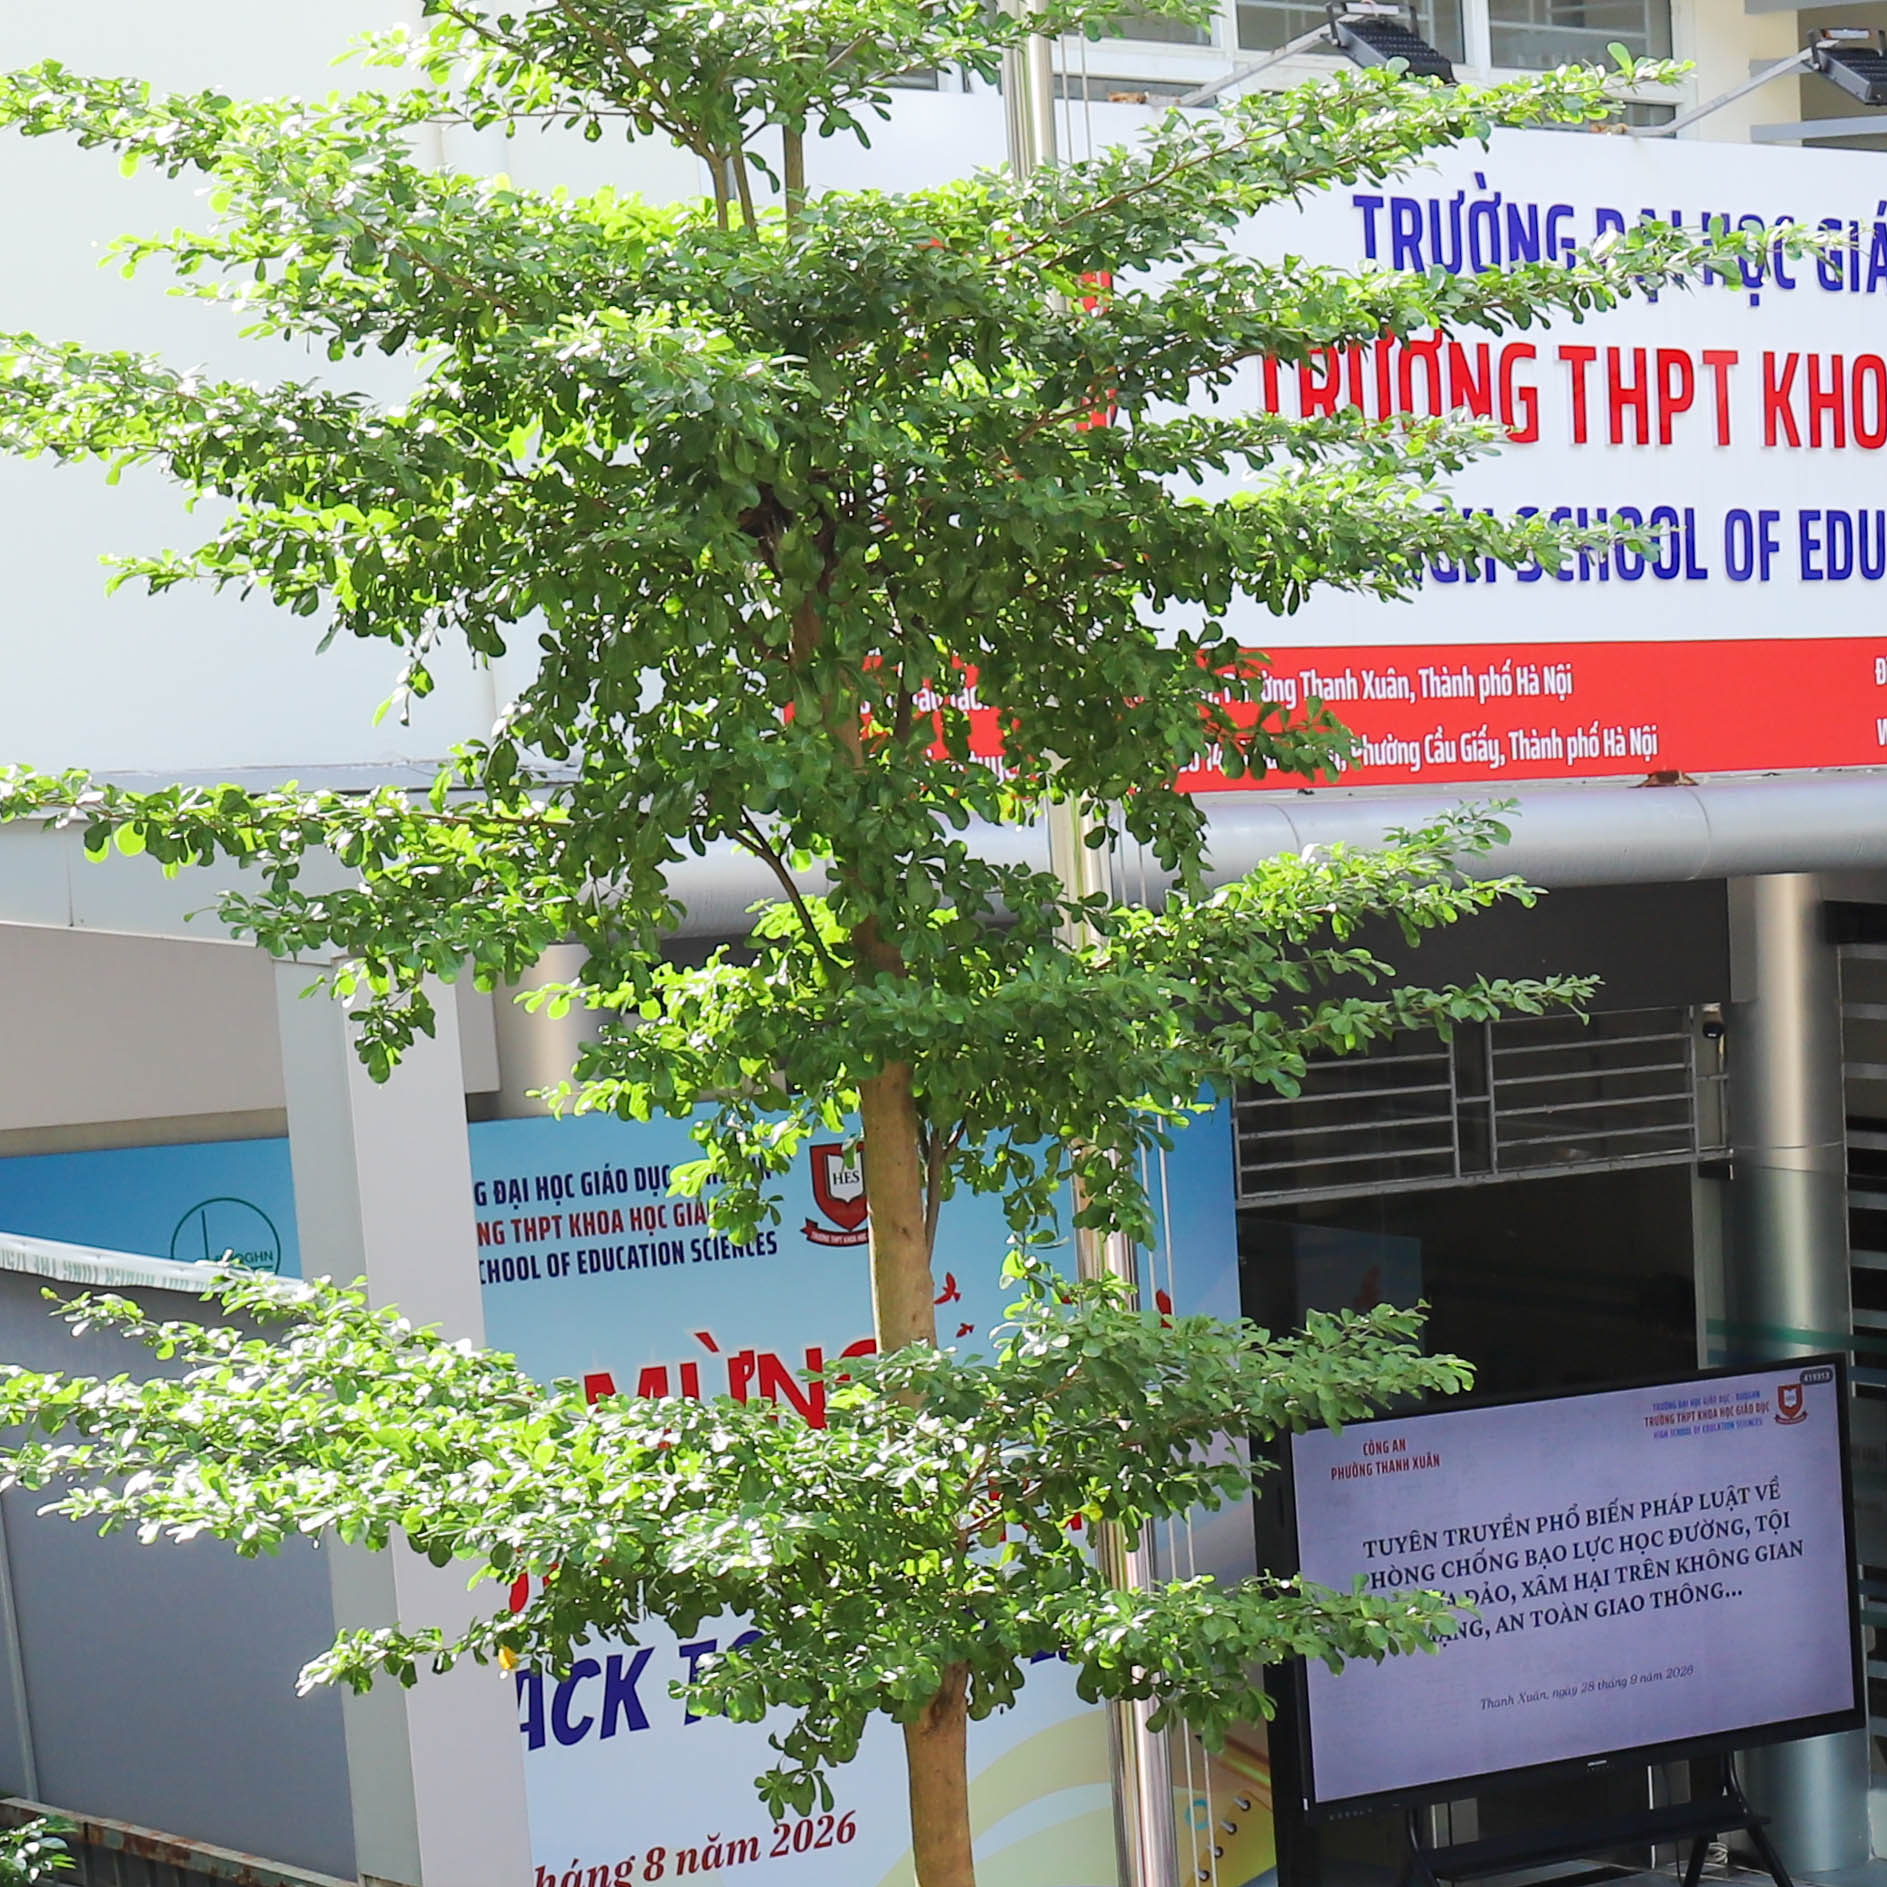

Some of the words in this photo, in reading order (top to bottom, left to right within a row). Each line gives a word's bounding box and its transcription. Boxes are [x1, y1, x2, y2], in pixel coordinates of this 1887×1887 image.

[1353, 171, 1575, 275] TRƯỜNG
[1559, 344, 1739, 447] THPT
[1723, 508, 1780, 583] OF
[1299, 668, 1359, 701] Thanh
[1361, 667, 1417, 704] Xuân,
[1418, 666, 1475, 701] Thành
[1479, 658, 1512, 704] phố
[1515, 665, 1541, 697] Hà
[1543, 663, 1573, 702] Nội
[1425, 725, 1457, 765] Cầu
[1460, 723, 1506, 770] Giấy,
[1508, 729, 1562, 763] Thành
[1567, 721, 1600, 766] phố
[1603, 727, 1627, 759] Hà
[1629, 725, 1658, 762] Nội
[494, 1177, 529, 1210] ĐẠI
[536, 1174, 574, 1207] HỌC
[581, 1163, 627, 1200] GIÁO
[636, 1164, 670, 1197] DỤC
[833, 1171, 860, 1185] HES
[511, 1215, 562, 1243] THPT
[569, 1209, 623, 1238] KHOA
[631, 1204, 667, 1236] HỌC
[547, 1252, 570, 1278] OF
[578, 1243, 685, 1275] EDUCATION
[691, 1231, 778, 1263] SCIENCES
[1363, 1438, 1389, 1456] CÔNG
[1392, 1438, 1406, 1452] AN
[1376, 1457, 1410, 1475] THANH
[1413, 1452, 1440, 1469] XUÂN
[1363, 1530, 1438, 1558] TUYÊN
[1444, 1513, 1530, 1546] TRUYỀN
[1536, 1503, 1580, 1533] PHỔ
[1587, 1498, 1634, 1527] BIẾN
[1641, 1493, 1693, 1518] PHÁP
[1699, 1485, 1750, 1511] LUẬT
[1754, 1475, 1781, 1502] VỀ
[1441, 1548, 1519, 1579] CHỐNG
[1526, 1545, 1567, 1570] BẠO
[1573, 1536, 1614, 1562] LỰC
[1619, 1531, 1663, 1555] HỌC
[1669, 1518, 1750, 1545] ĐƯỜNG,
[1755, 1509, 1790, 1536] TỘI
[1521, 1574, 1567, 1599] XÂM
[1575, 1569, 1609, 1593] HẠI
[1615, 1559, 1670, 1584] TRÊN
[1677, 1549, 1749, 1575] KHÔNG
[1755, 1540, 1803, 1562] GIAN
[1495, 1613, 1524, 1634] AN
[1530, 1601, 1588, 1628] TOÀN
[1595, 1594, 1645, 1617] GIAO
[1650, 1582, 1742, 1608] THÔNG...
[643, 1847, 665, 1880] 8
[677, 1831, 760, 1876] năm
[771, 1811, 856, 1858] 2026
